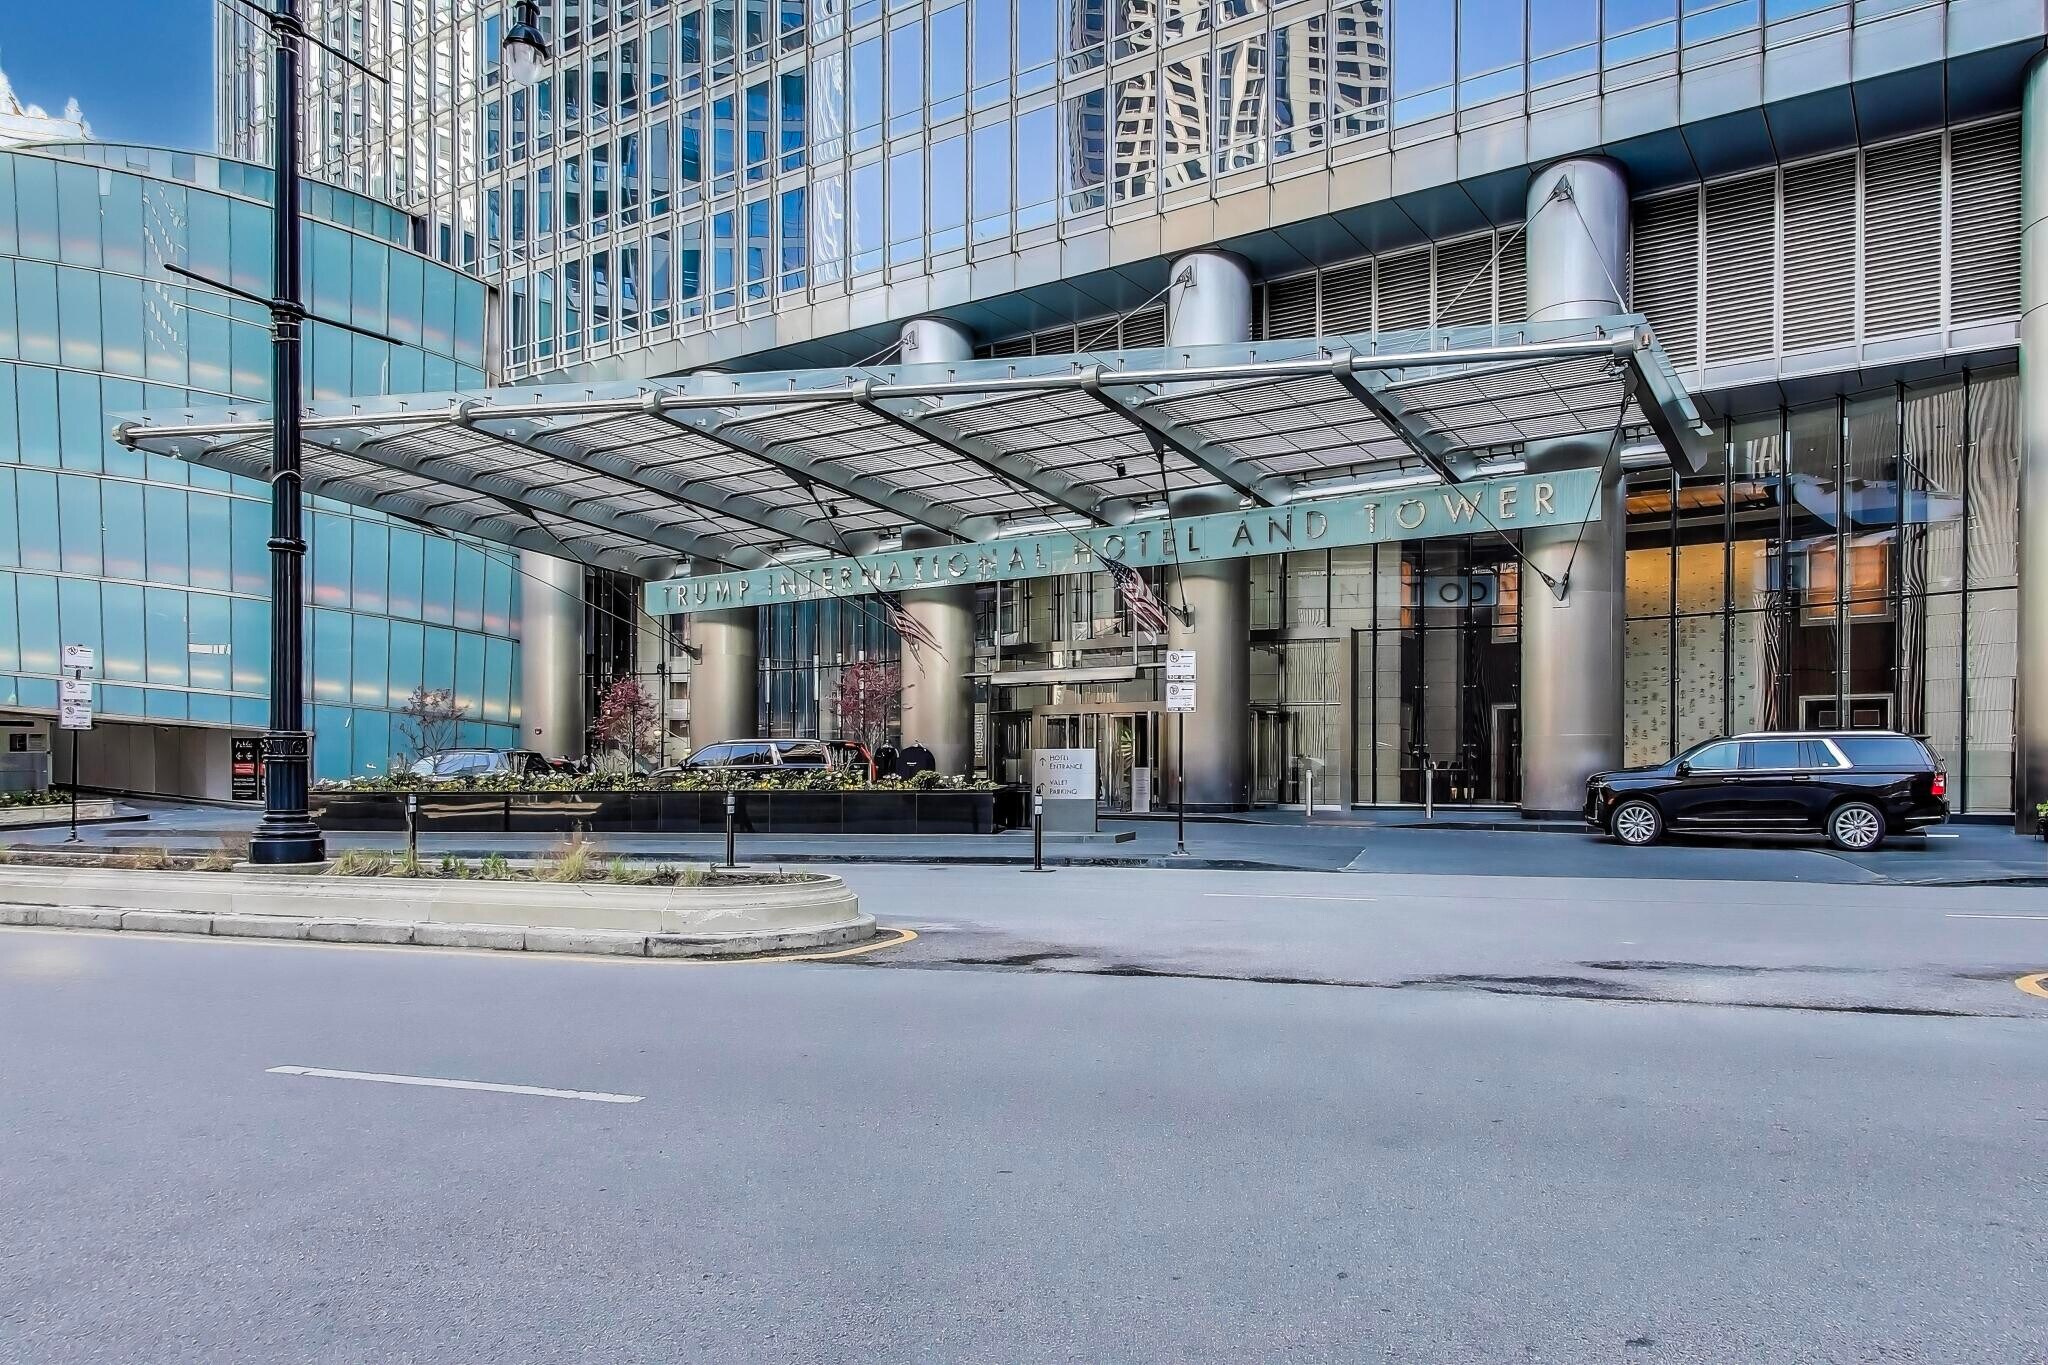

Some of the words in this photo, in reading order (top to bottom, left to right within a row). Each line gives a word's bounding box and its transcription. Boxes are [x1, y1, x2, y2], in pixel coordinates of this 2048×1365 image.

[663, 578, 750, 611] TRUMP
[768, 543, 1047, 597] INTERNATIONAL
[1073, 526, 1200, 565] HOTEL
[1233, 510, 1328, 548] AND
[1363, 482, 1556, 535] TOWER
